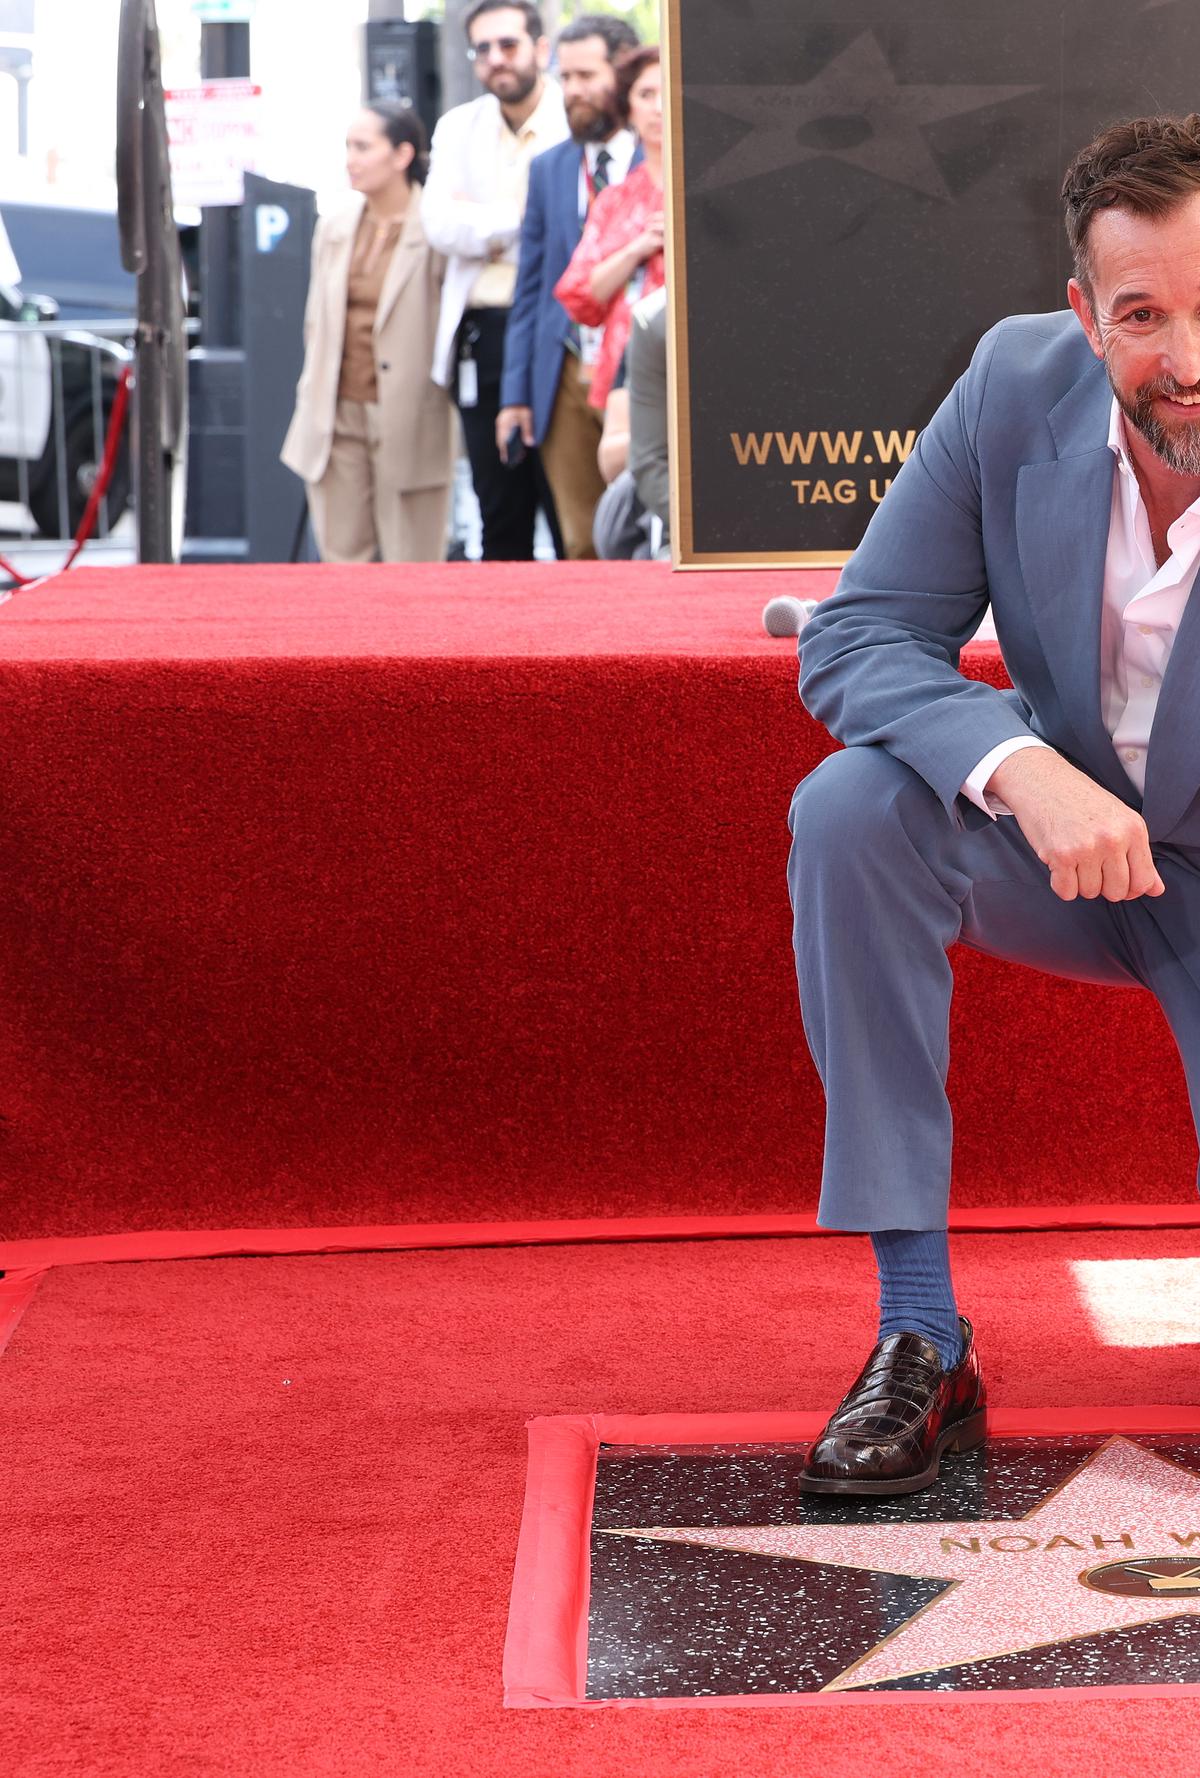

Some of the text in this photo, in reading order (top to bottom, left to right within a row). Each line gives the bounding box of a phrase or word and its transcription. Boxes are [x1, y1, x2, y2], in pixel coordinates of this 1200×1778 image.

[256, 204, 289, 252] P
[730, 430, 916, 465] WWW.W
[791, 479, 857, 504] TAG
[939, 1532, 1135, 1554] NOAH
